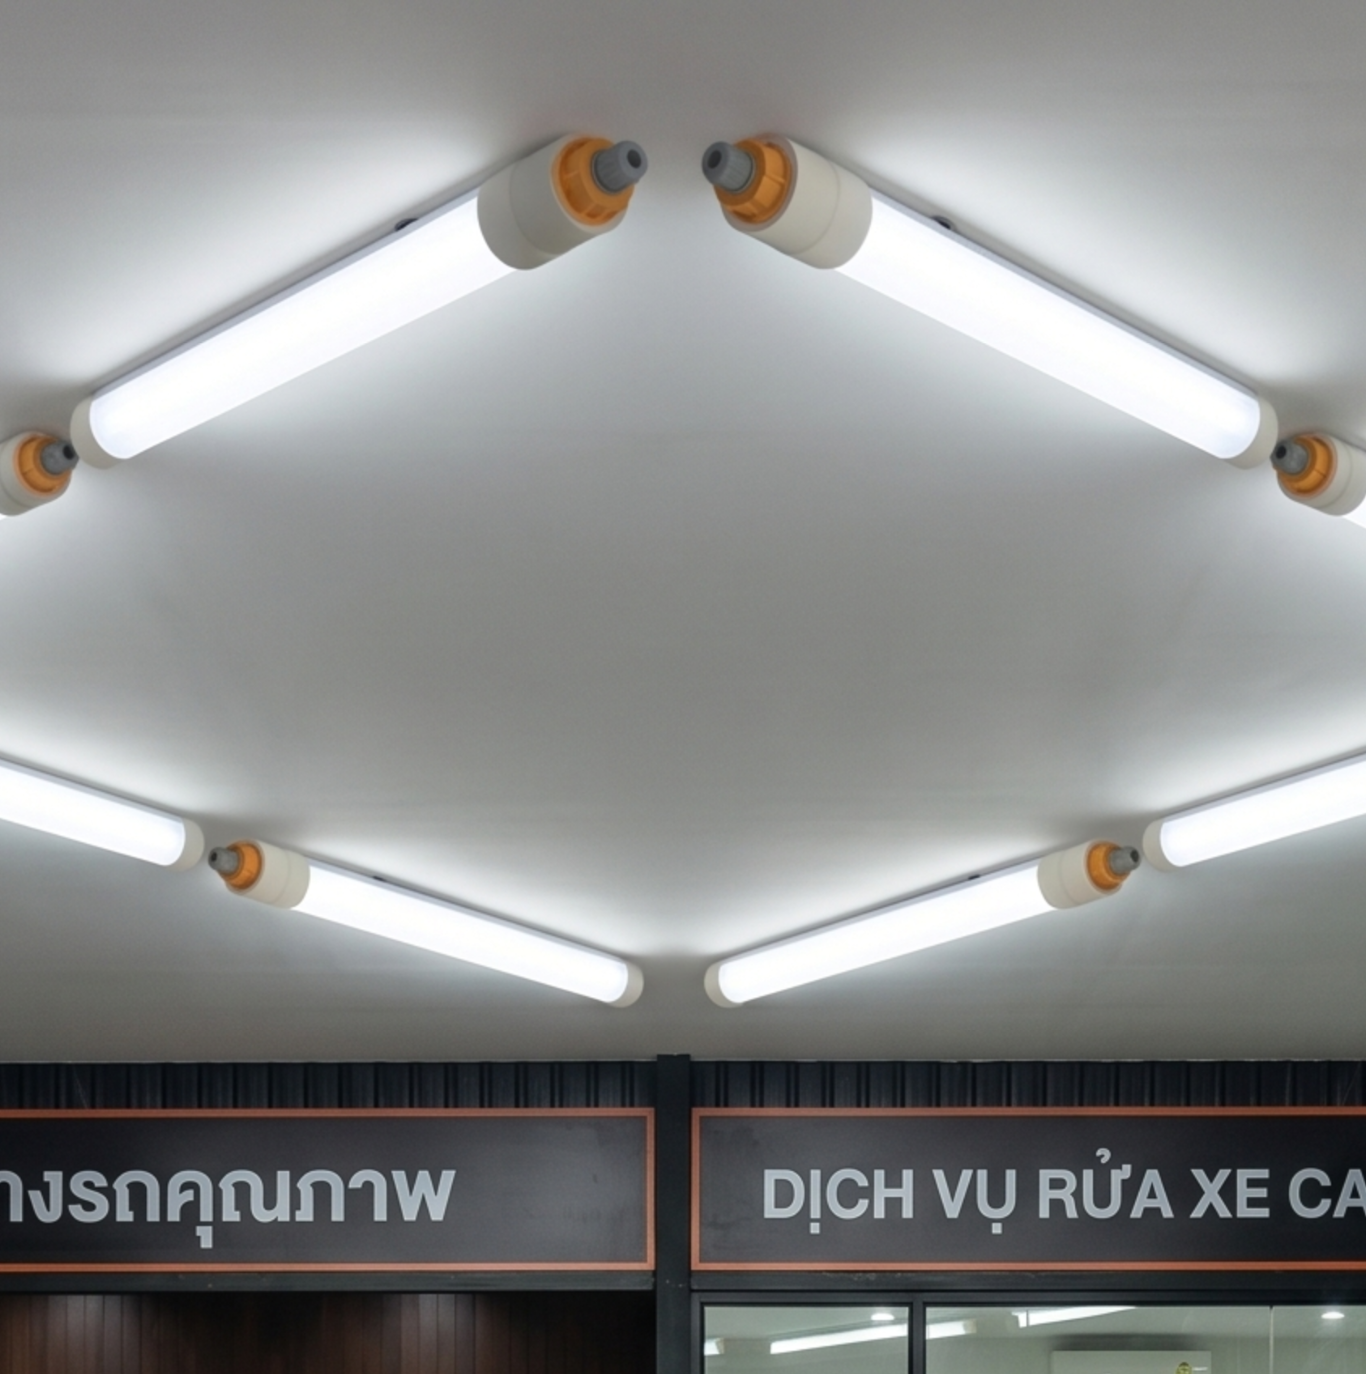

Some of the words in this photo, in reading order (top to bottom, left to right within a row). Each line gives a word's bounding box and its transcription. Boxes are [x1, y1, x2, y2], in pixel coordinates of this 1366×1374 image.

[763, 1167, 914, 1235] DỊCH
[931, 1168, 1017, 1235] VỤ
[1038, 1147, 1175, 1219] RỬA
[1189, 1168, 1270, 1219] XE
